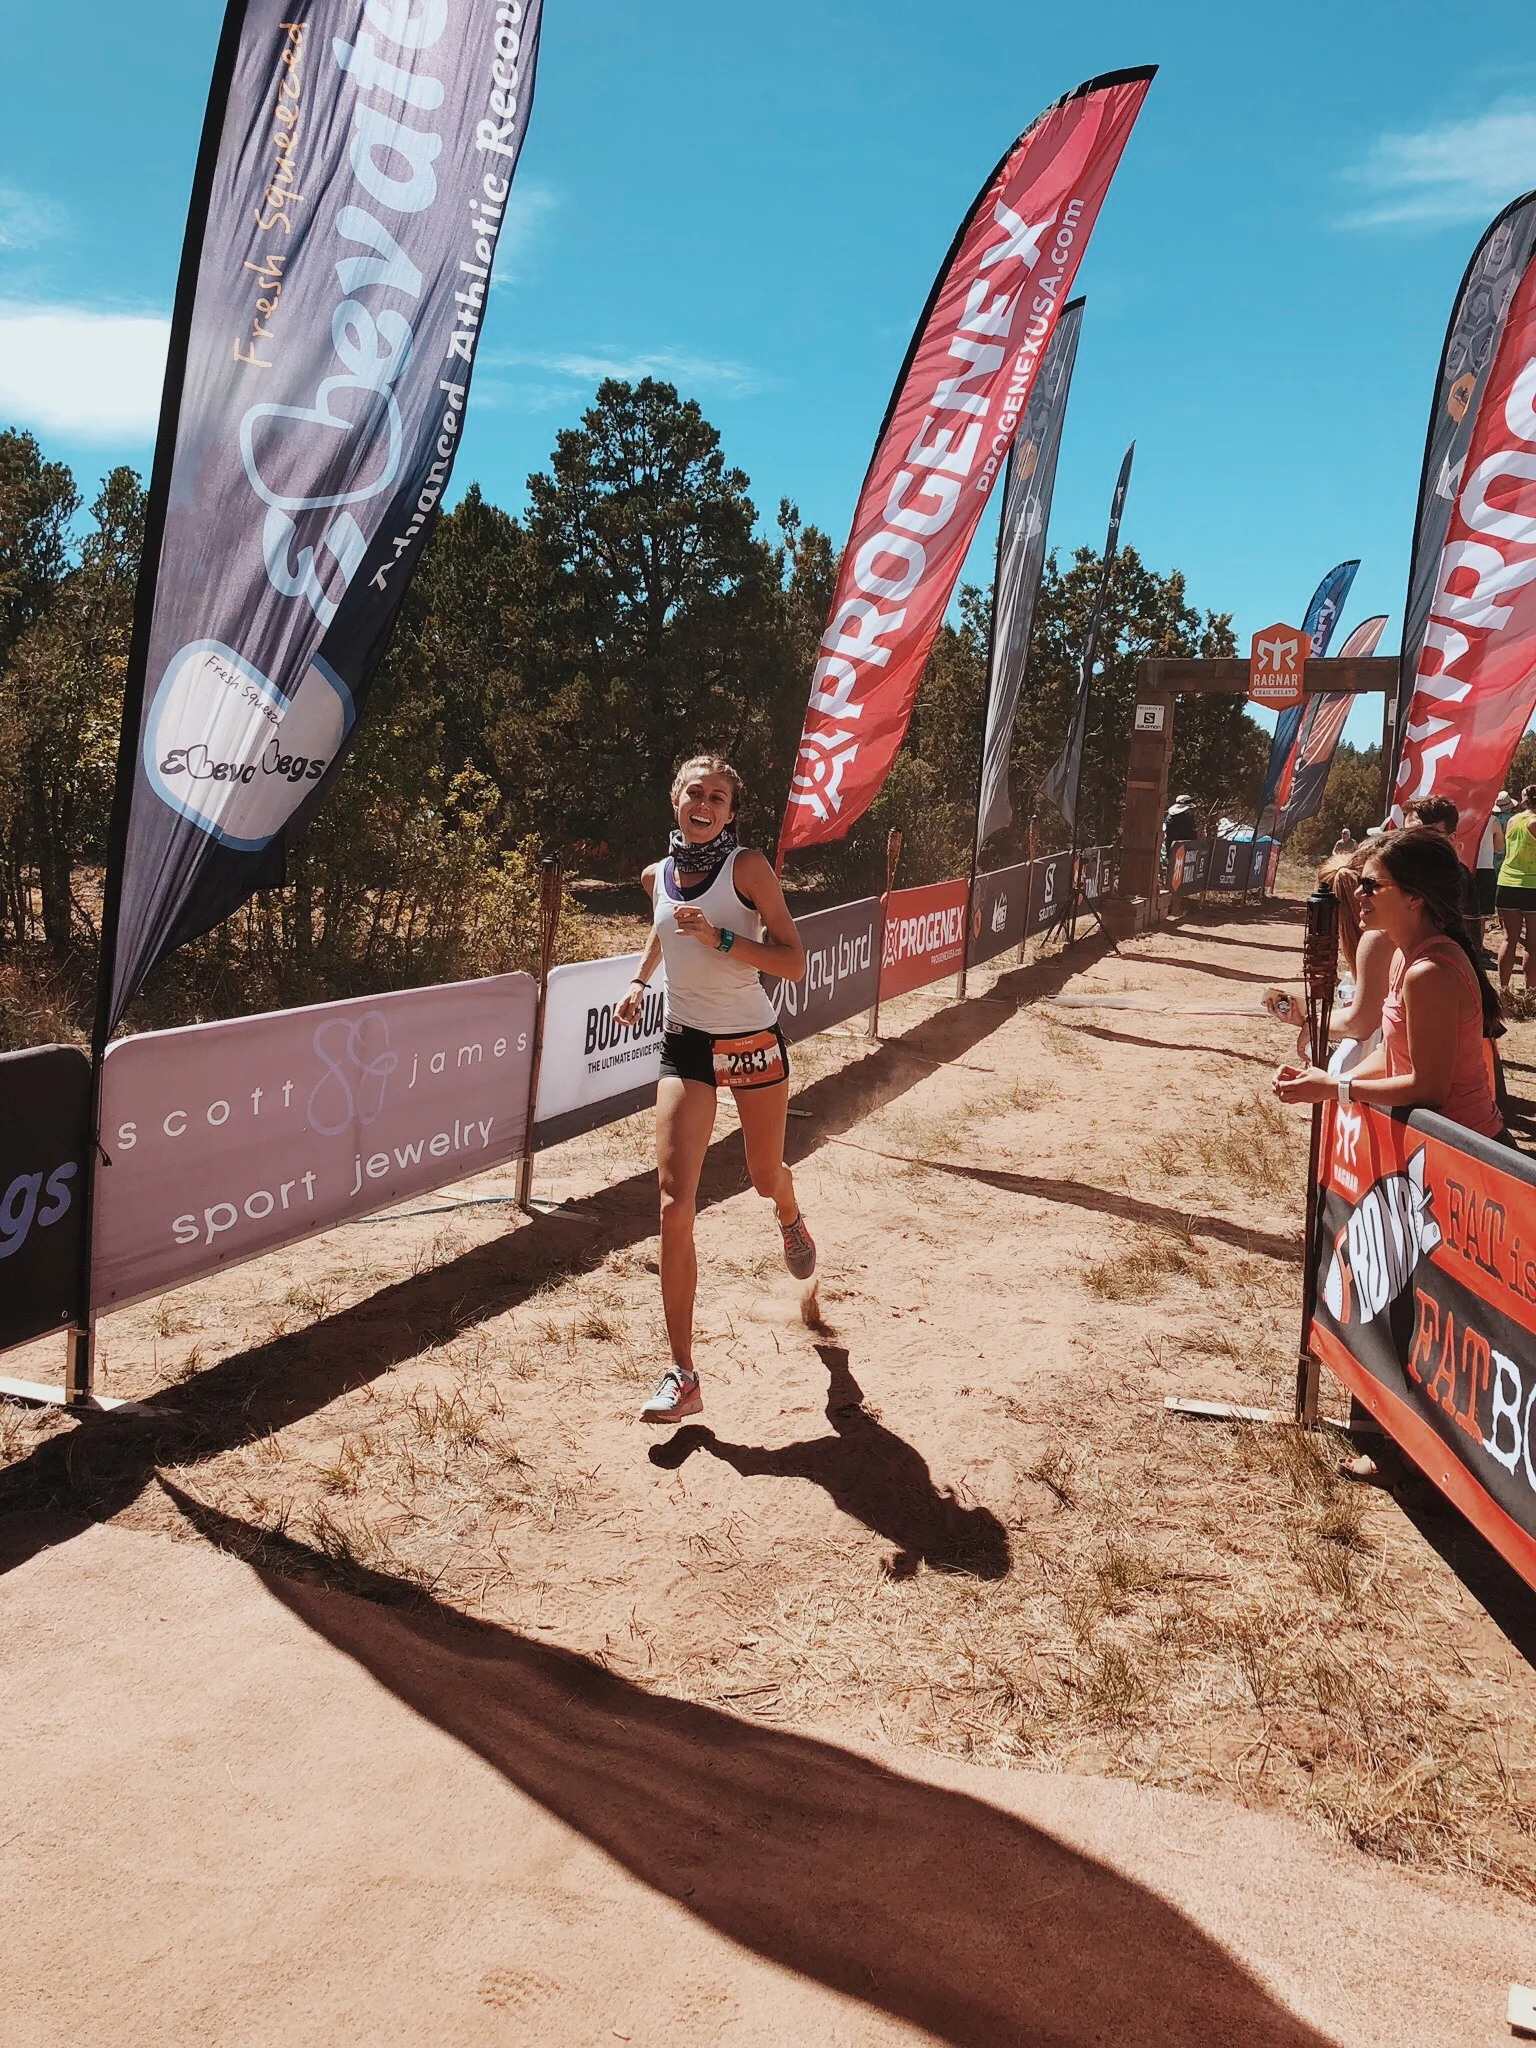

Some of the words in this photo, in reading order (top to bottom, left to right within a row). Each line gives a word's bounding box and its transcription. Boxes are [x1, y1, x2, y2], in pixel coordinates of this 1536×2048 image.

[254, 22, 307, 234] Squeezed
[233, 255, 287, 368] Fresh
[447, 173, 509, 364] Athletic
[976, 197, 1085, 493] PROGENEXUSA.com
[808, 198, 1058, 720] PROGENEX
[204, 655, 240, 690] Fresh
[1253, 673, 1298, 686] RAGNAR
[803, 923, 873, 1012] jaybird
[898, 905, 965, 960] PROGENEX
[117, 1079, 294, 1151] scott
[408, 1031, 528, 1088] james
[588, 1061, 601, 1074] THE
[602, 1051, 631, 1070] ULTIMATE
[632, 1045, 652, 1060] DEVICE
[728, 1048, 768, 1076] 283
[171, 1169, 317, 1245] sport
[349, 1116, 495, 1197] jewelry
[1334, 1164, 1359, 1194] RAGNAR
[1446, 1178, 1505, 1284] FAT
